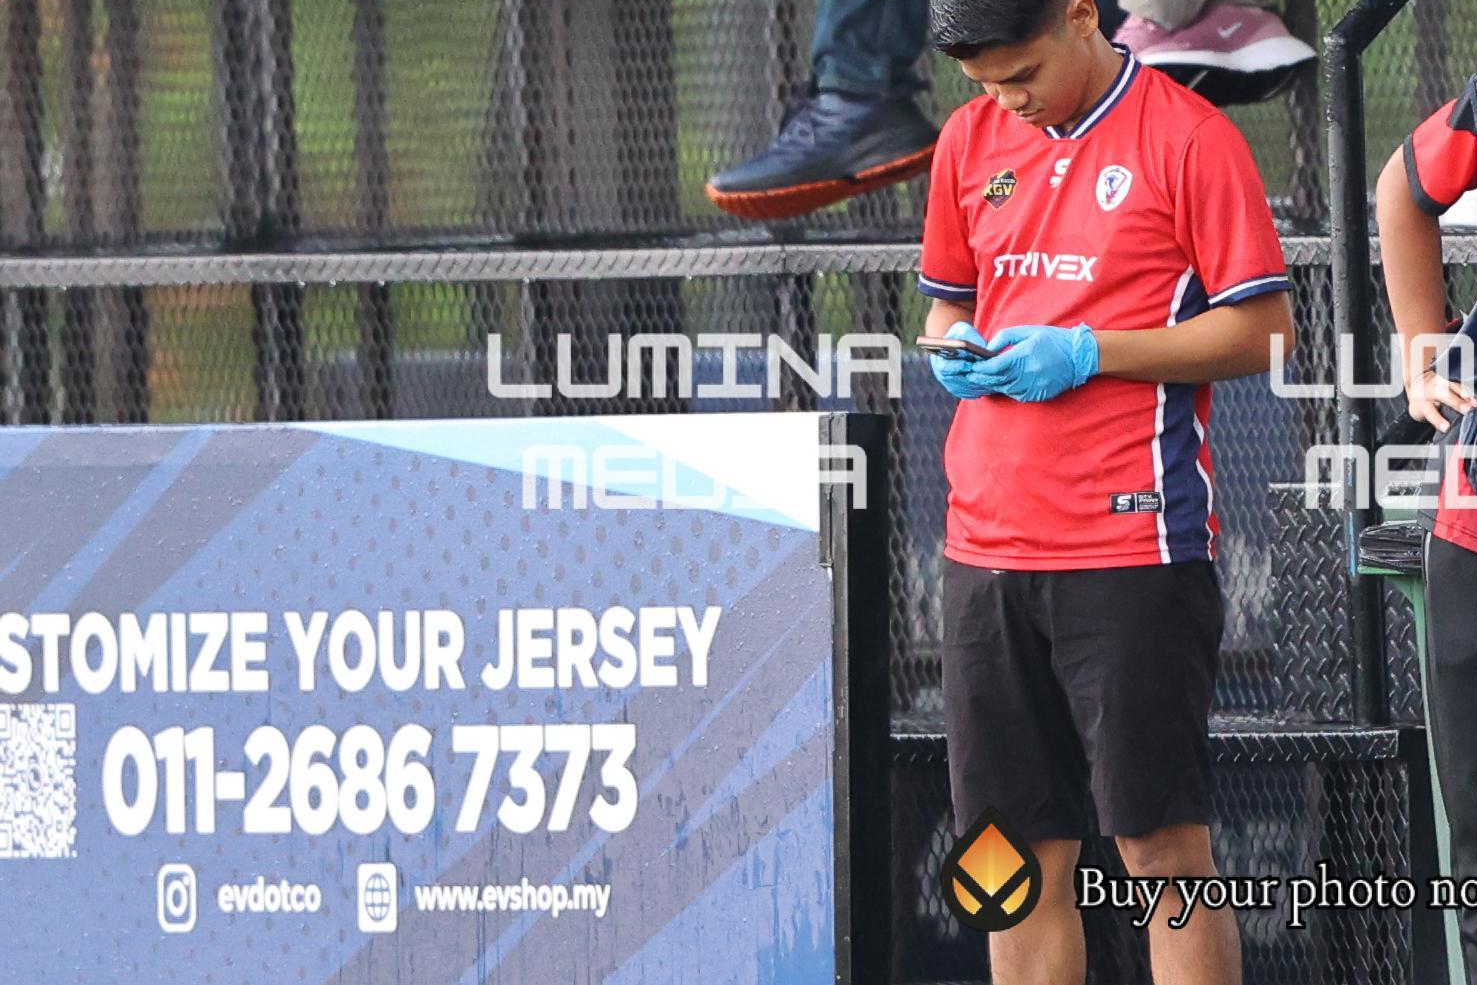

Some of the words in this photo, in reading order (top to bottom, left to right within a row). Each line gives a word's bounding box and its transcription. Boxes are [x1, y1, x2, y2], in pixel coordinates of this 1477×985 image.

[0, 611, 269, 695] STOMIZE
[284, 609, 466, 692] YOUR
[481, 606, 722, 690] JERSEY
[102, 724, 436, 836] 011-2686
[451, 723, 638, 834] 7373
[217, 875, 322, 913] evdotco
[414, 877, 611, 918] www.evshop.my
